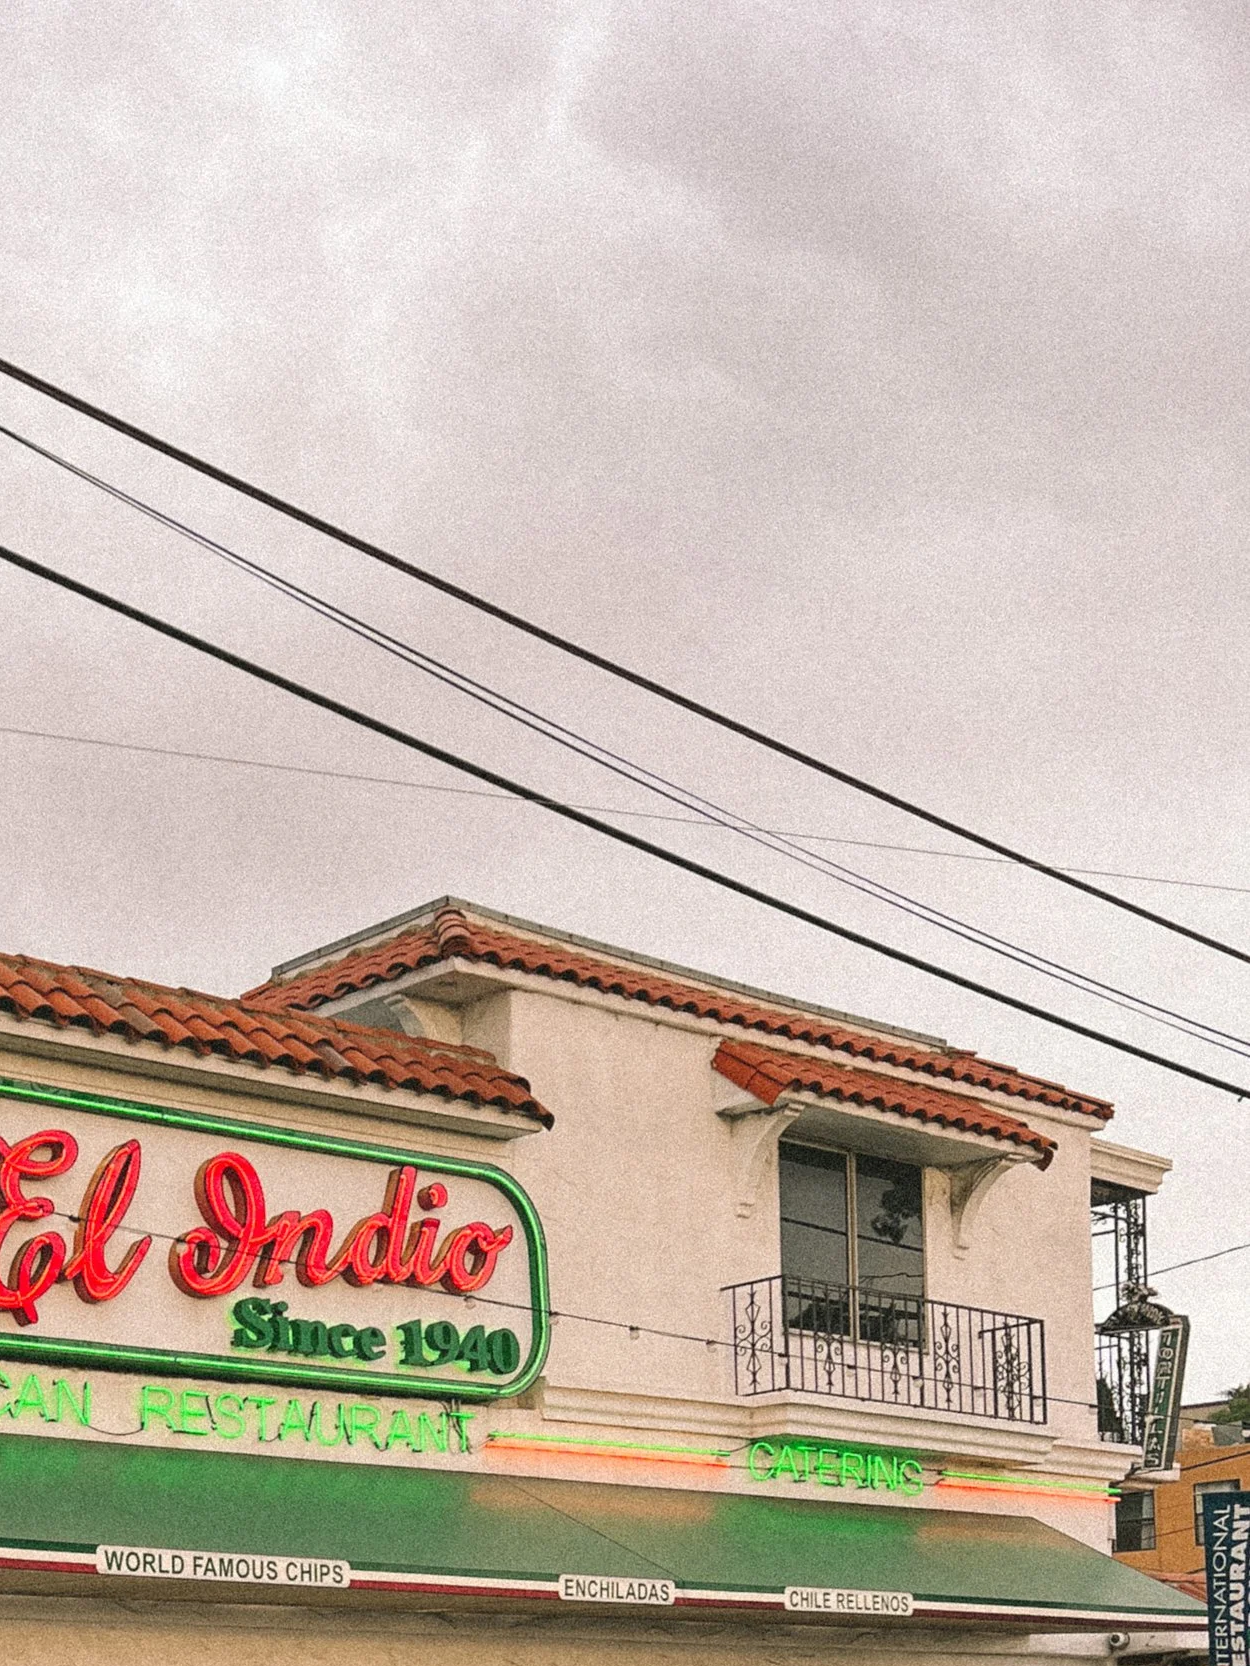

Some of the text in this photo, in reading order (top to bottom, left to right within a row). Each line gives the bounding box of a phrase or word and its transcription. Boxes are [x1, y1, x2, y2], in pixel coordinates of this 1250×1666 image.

[169, 1152, 512, 1298] Indio
[232, 1296, 520, 1376] Since 1940
[142, 1385, 476, 1453] RESTAURANT
[750, 1442, 924, 1496] CATERING
[104, 1549, 344, 1584] WORLD FAMOUS CHIPS
[564, 1578, 670, 1602] ENCHILADAS
[789, 1590, 910, 1613] CHILE RELLENOS
